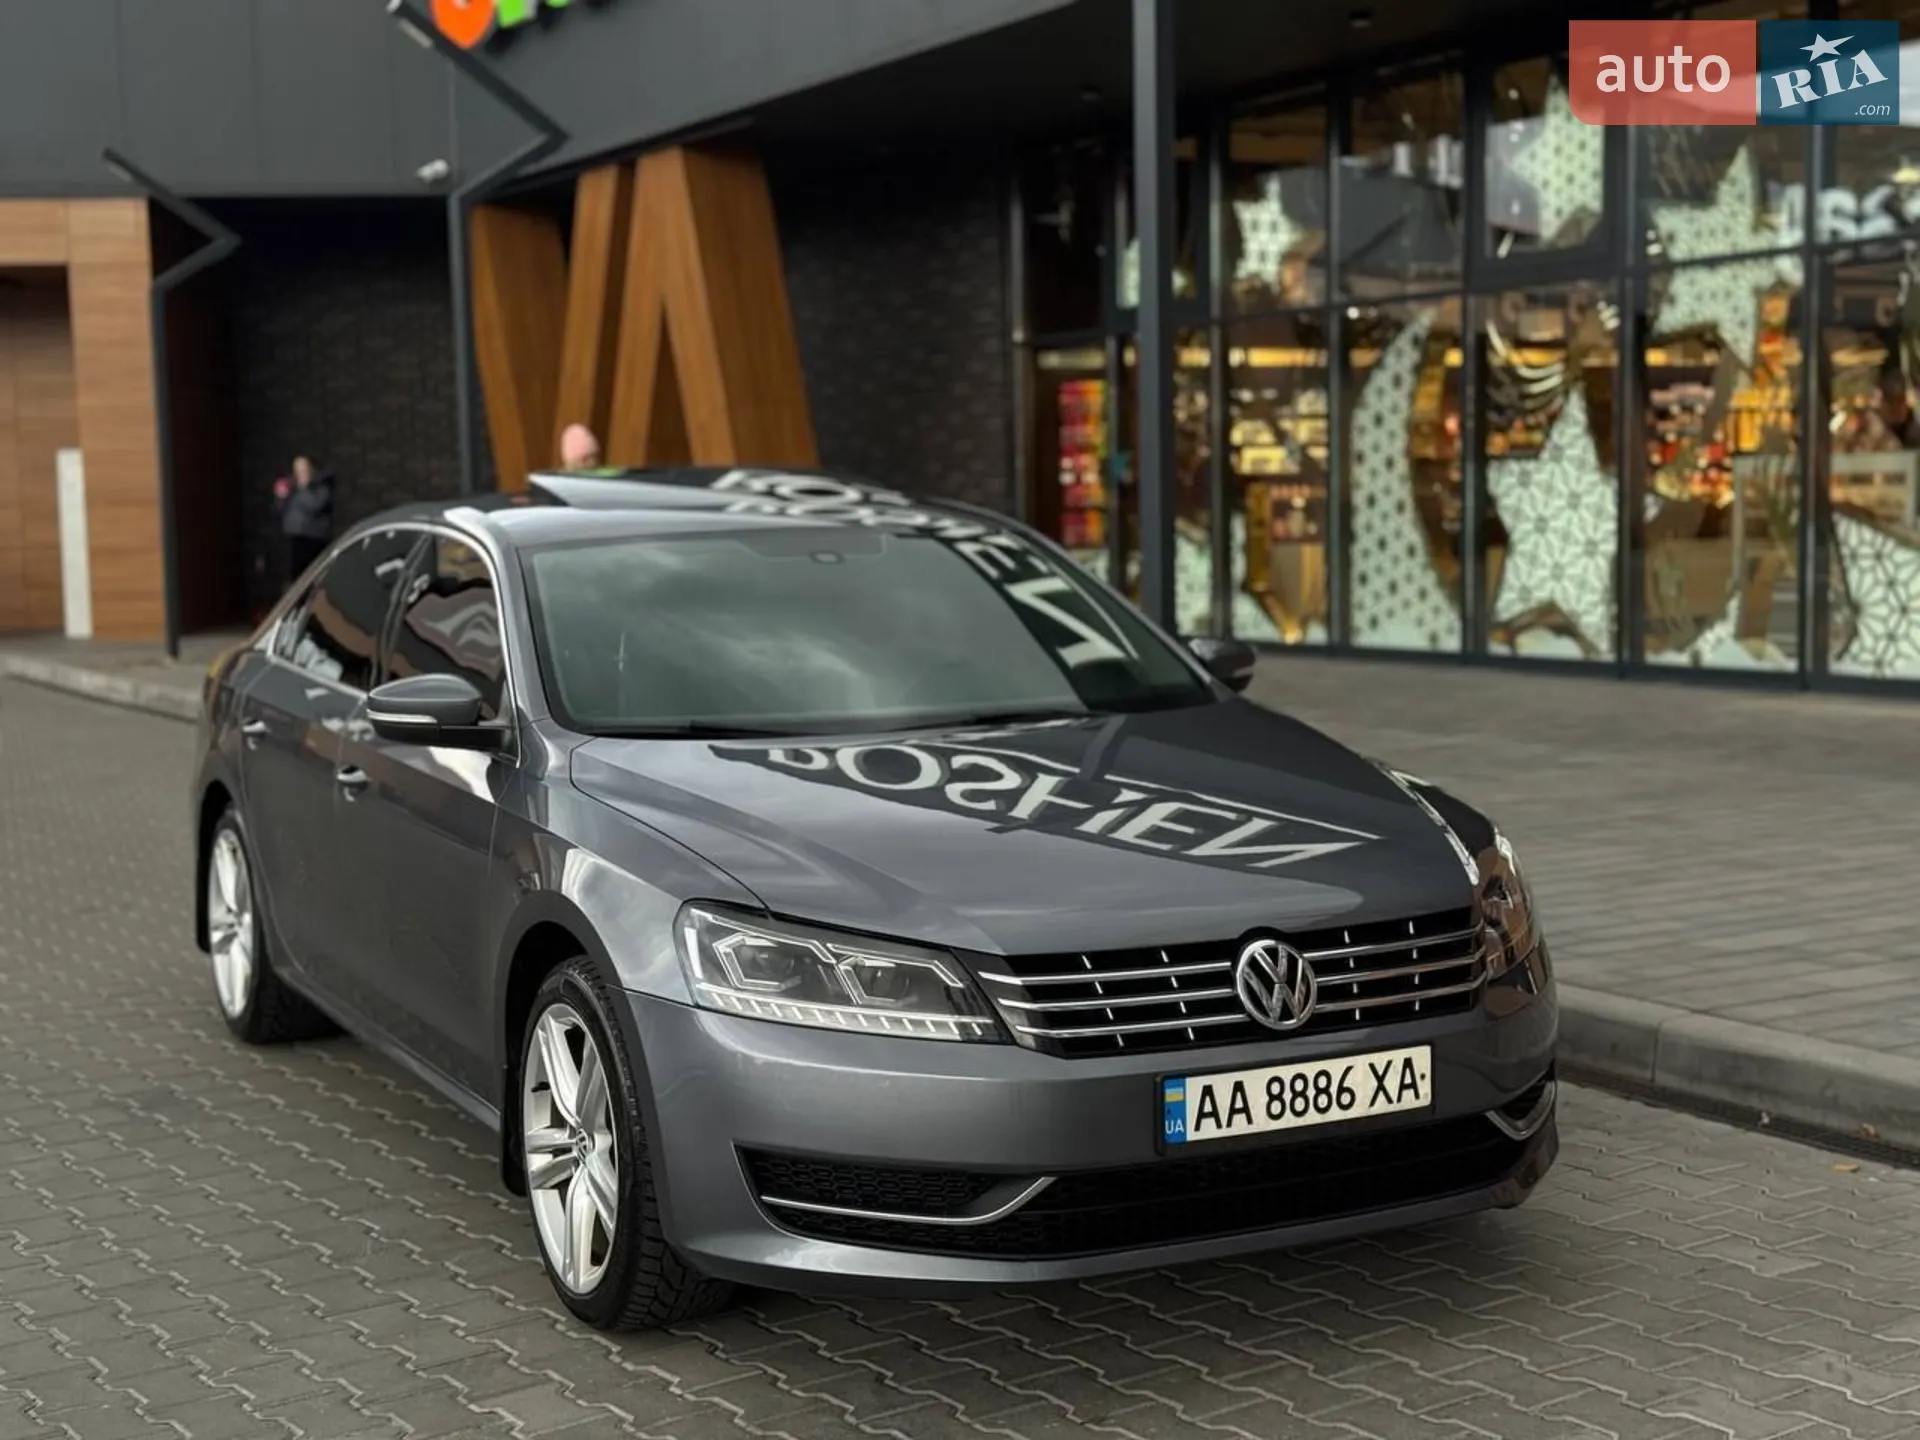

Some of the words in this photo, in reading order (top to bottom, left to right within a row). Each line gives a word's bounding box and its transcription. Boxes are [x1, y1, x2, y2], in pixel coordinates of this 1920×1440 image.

[1194, 1080, 1253, 1132] AA
[1265, 1066, 1356, 1121] 8886
[1369, 1056, 1420, 1107] XA
[1164, 1118, 1185, 1135] UA
